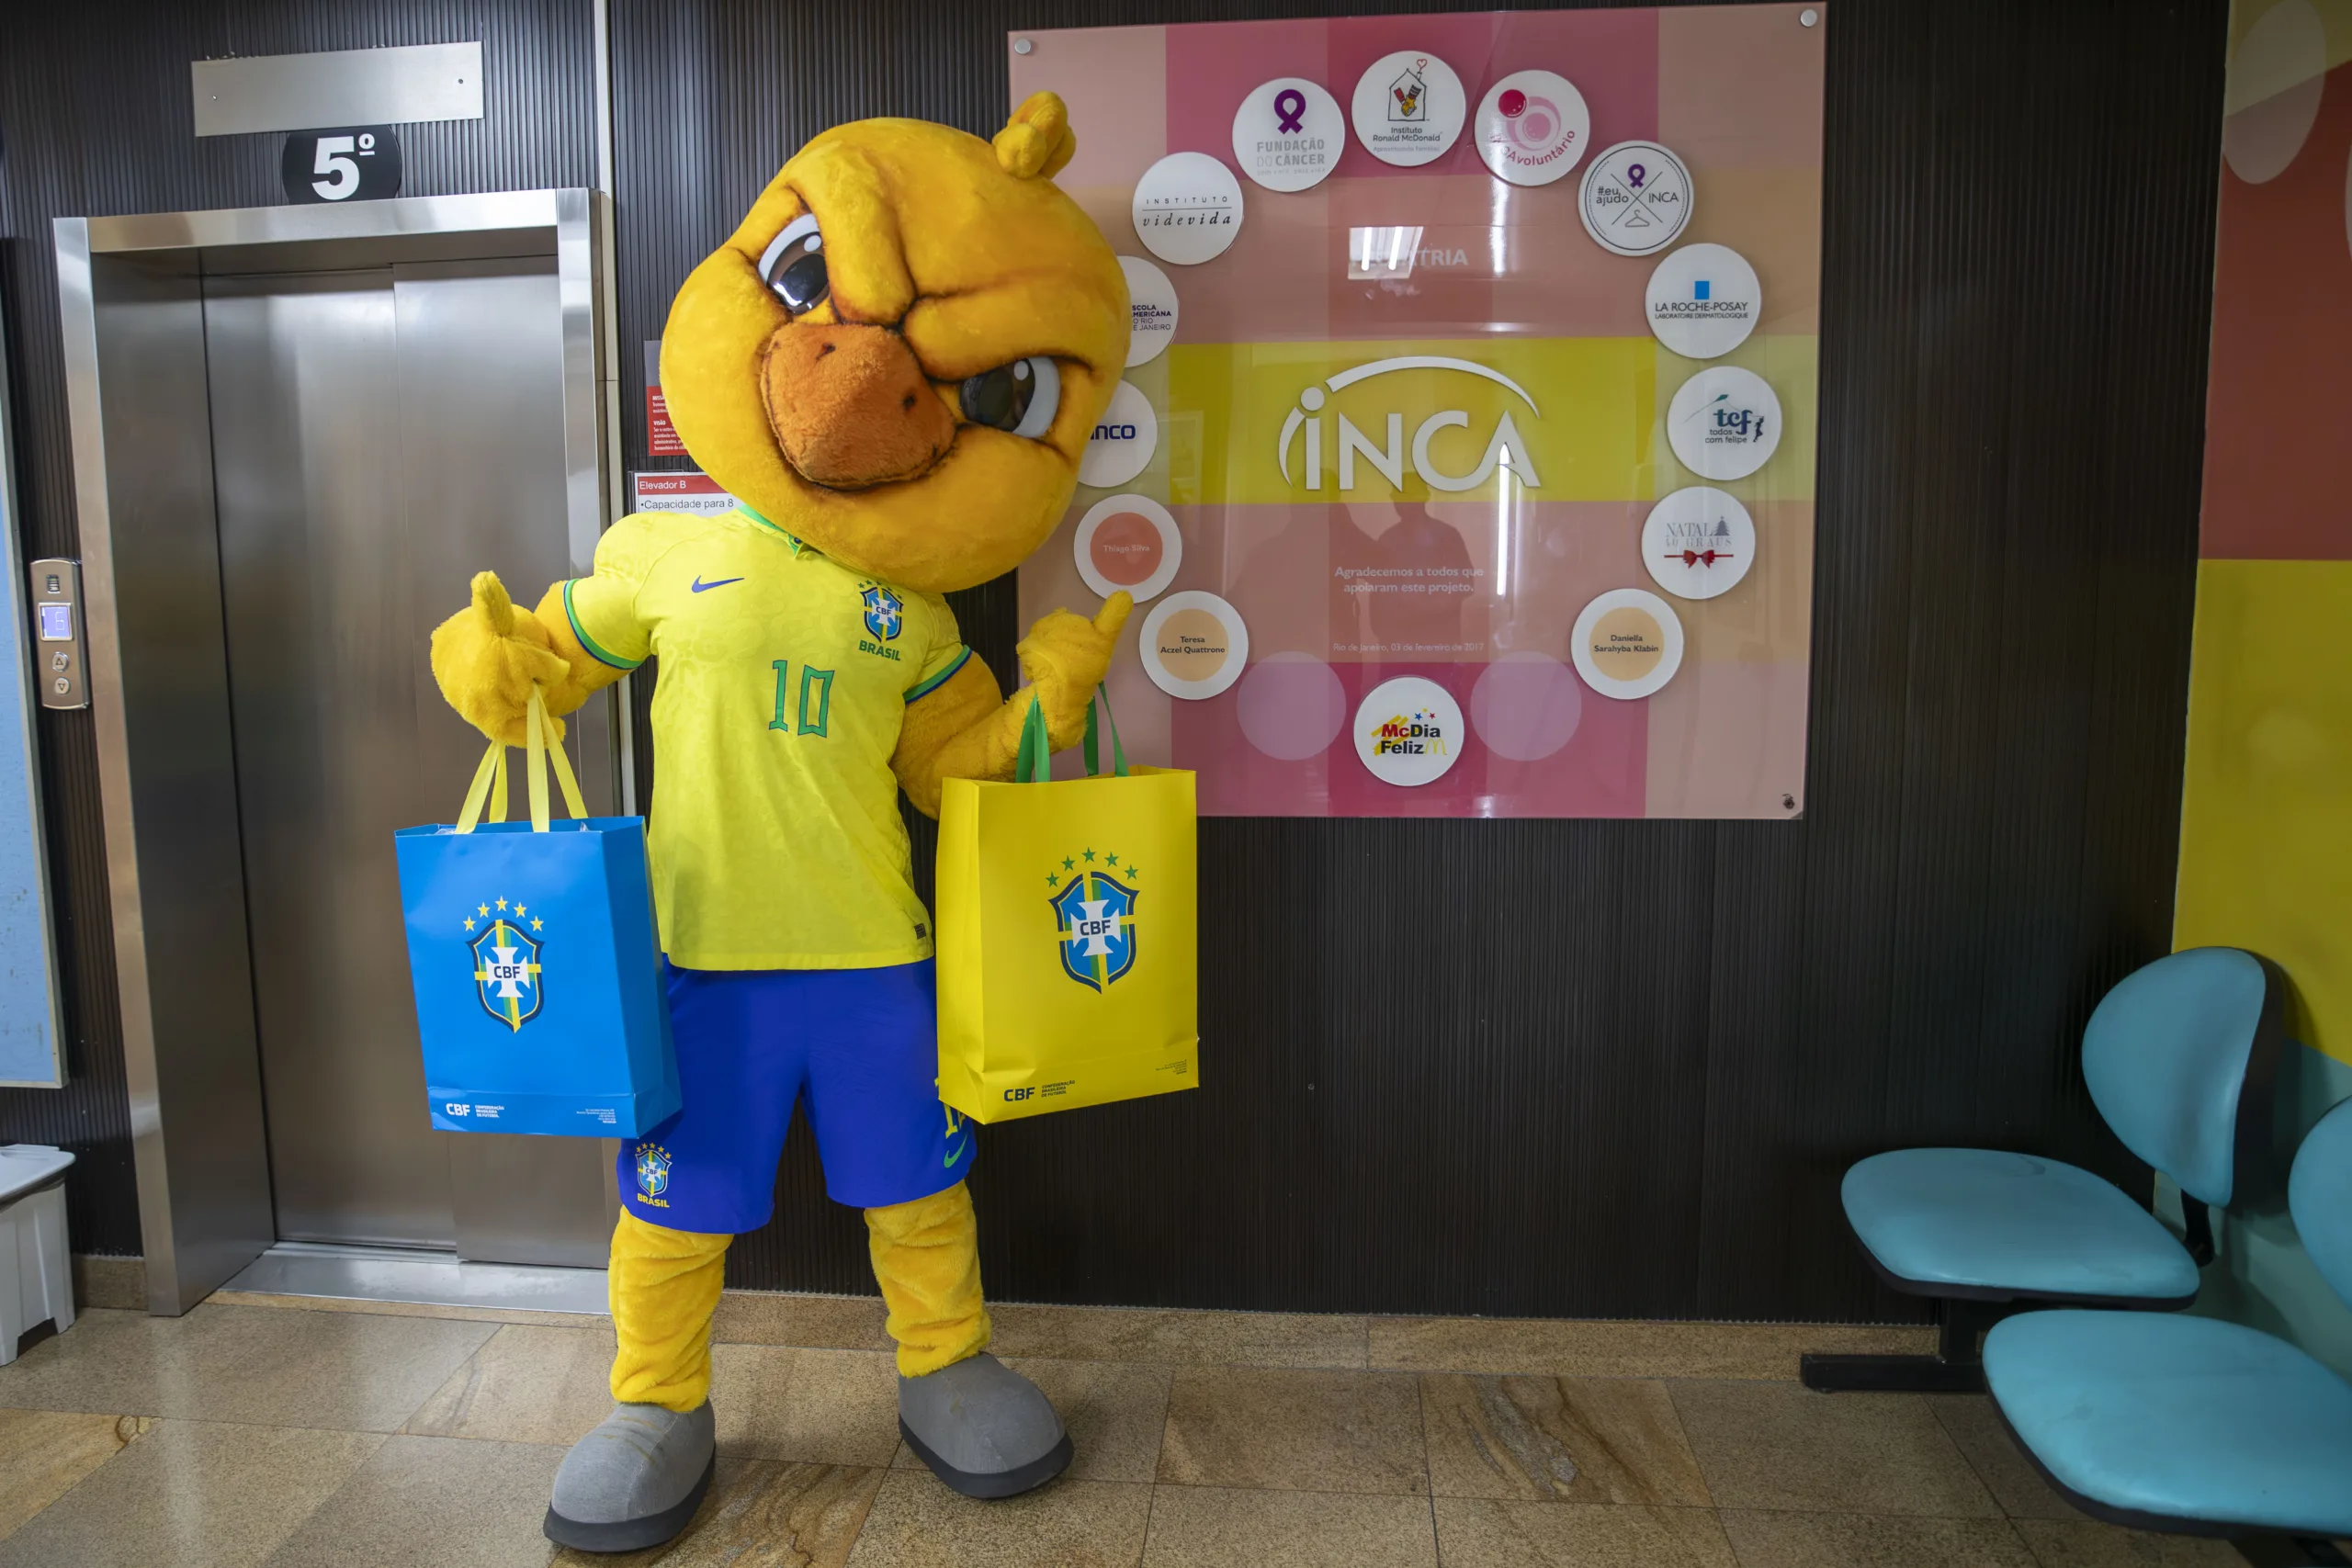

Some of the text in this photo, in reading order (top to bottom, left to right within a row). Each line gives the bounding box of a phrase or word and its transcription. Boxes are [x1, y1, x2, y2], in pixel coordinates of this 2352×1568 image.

[1257, 137, 1325, 152] FUNDAÇÃO
[1257, 152, 1325, 167] DO CÂNCER
[1597, 186, 1619, 196] #eu
[1648, 191, 1679, 204] INCA
[1146, 196, 1227, 205] INSTITUTO
[1596, 192, 1629, 207] ajudo
[1655, 301, 1748, 312] LA ROCHE-POSAY
[1725, 436, 1747, 445] felipe
[639, 480, 686, 490] Elevador B
[705, 501, 724, 510] para
[727, 499, 734, 507] 8
[1665, 523, 1713, 536] NATAL
[1686, 536, 1732, 547] GRAUS
[1102, 544, 1150, 553] Thiago Silva
[1334, 566, 1485, 579] Agradecemos a todos que
[1343, 582, 1398, 594] apoiaram
[1428, 582, 1474, 594] projeto.
[876, 606, 892, 616] CBF
[858, 639, 900, 661] BRASIL
[1360, 643, 1389, 652] Janeiro,
[1391, 643, 1400, 651] 03
[1594, 645, 1632, 654] Sarahyba
[768, 660, 835, 739] 10
[1381, 724, 1441, 738] McDia
[1380, 740, 1425, 755] Feliz
[1080, 919, 1112, 937] CBF
[492, 965, 521, 979] CBF
[1003, 1087, 1035, 1102] CBF
[446, 1102, 470, 1117] CBF
[645, 1168, 658, 1176] CBF
[638, 1192, 671, 1208] BRASIL
